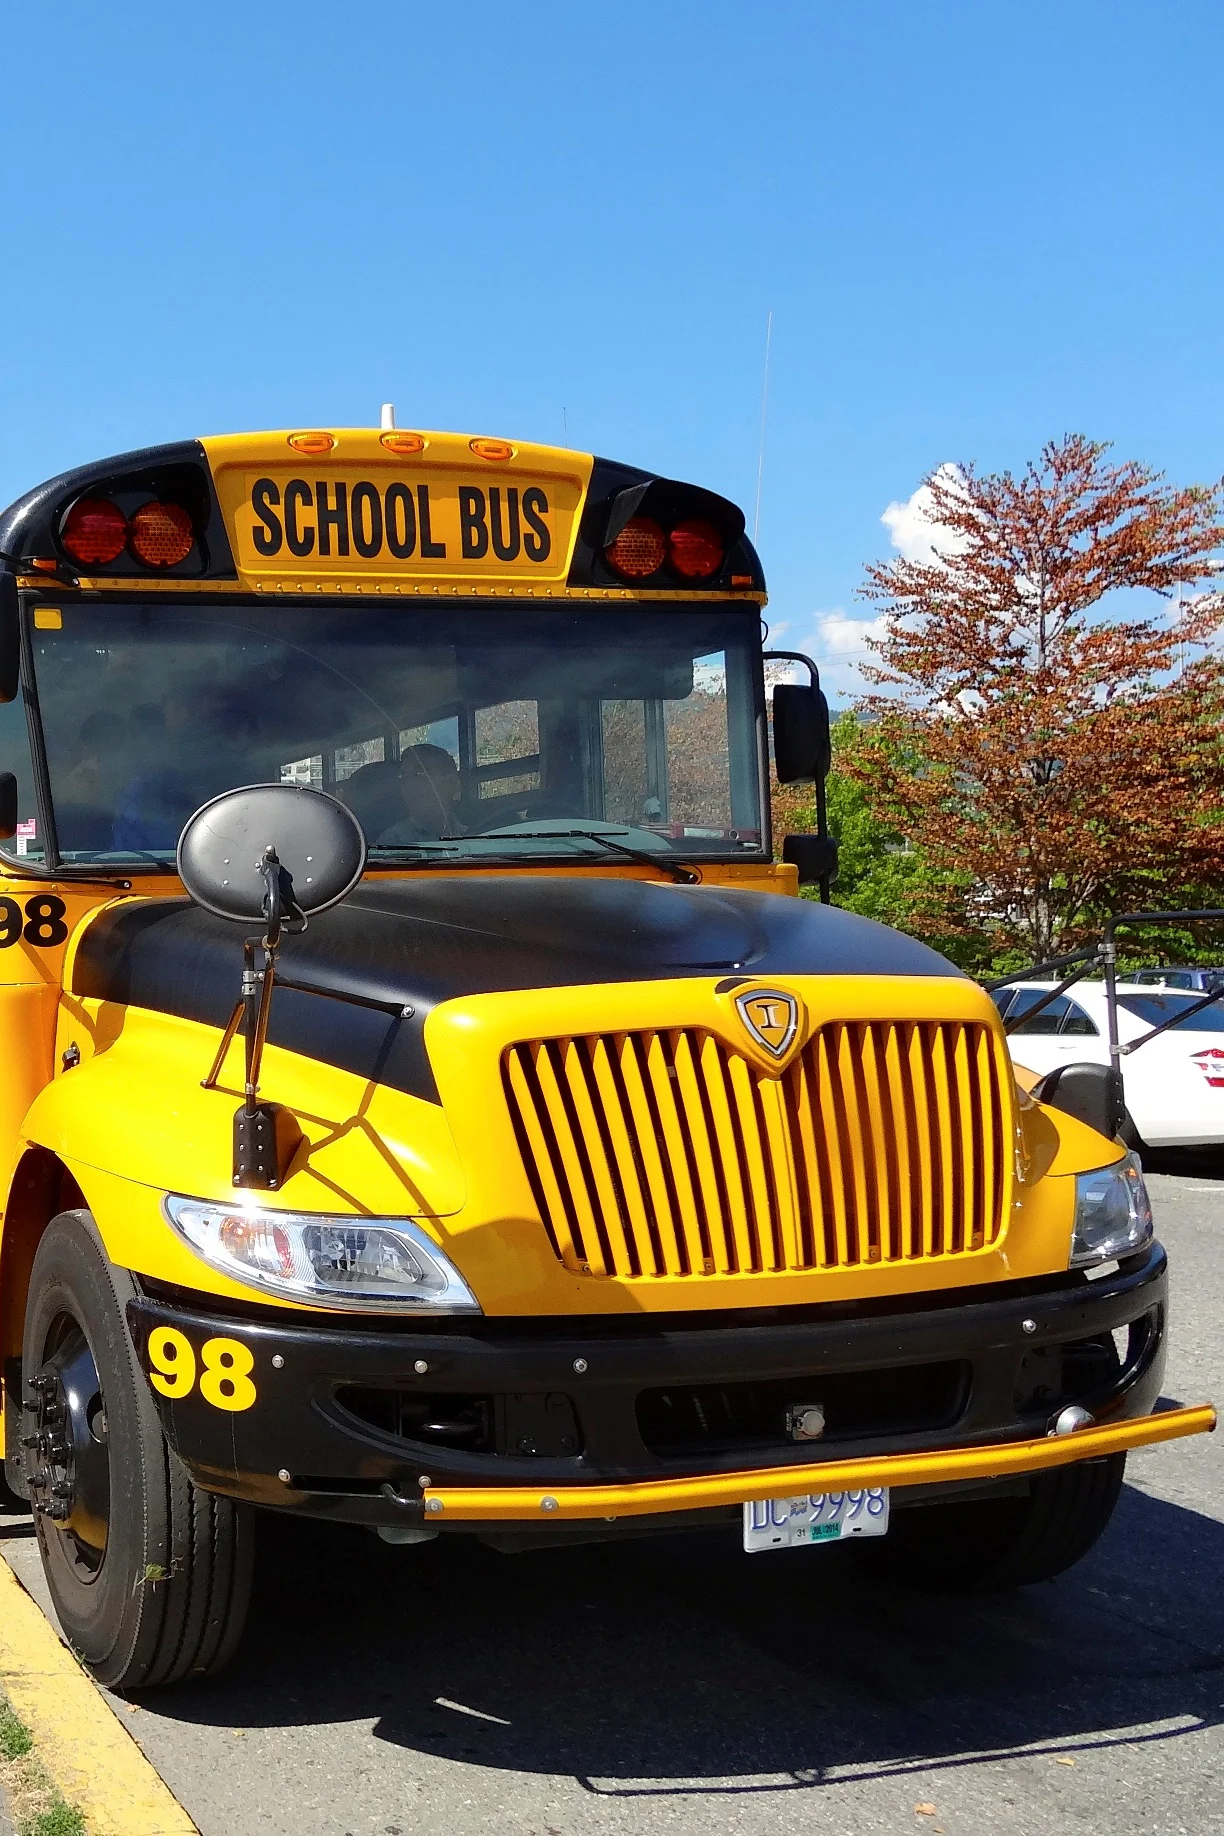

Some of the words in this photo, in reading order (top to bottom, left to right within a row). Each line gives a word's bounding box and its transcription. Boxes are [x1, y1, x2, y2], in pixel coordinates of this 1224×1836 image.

[251, 477, 447, 559] SCHOOL
[458, 484, 552, 563] BUS
[147, 1326, 257, 1412] 98
[796, 1528, 806, 1537] 31
